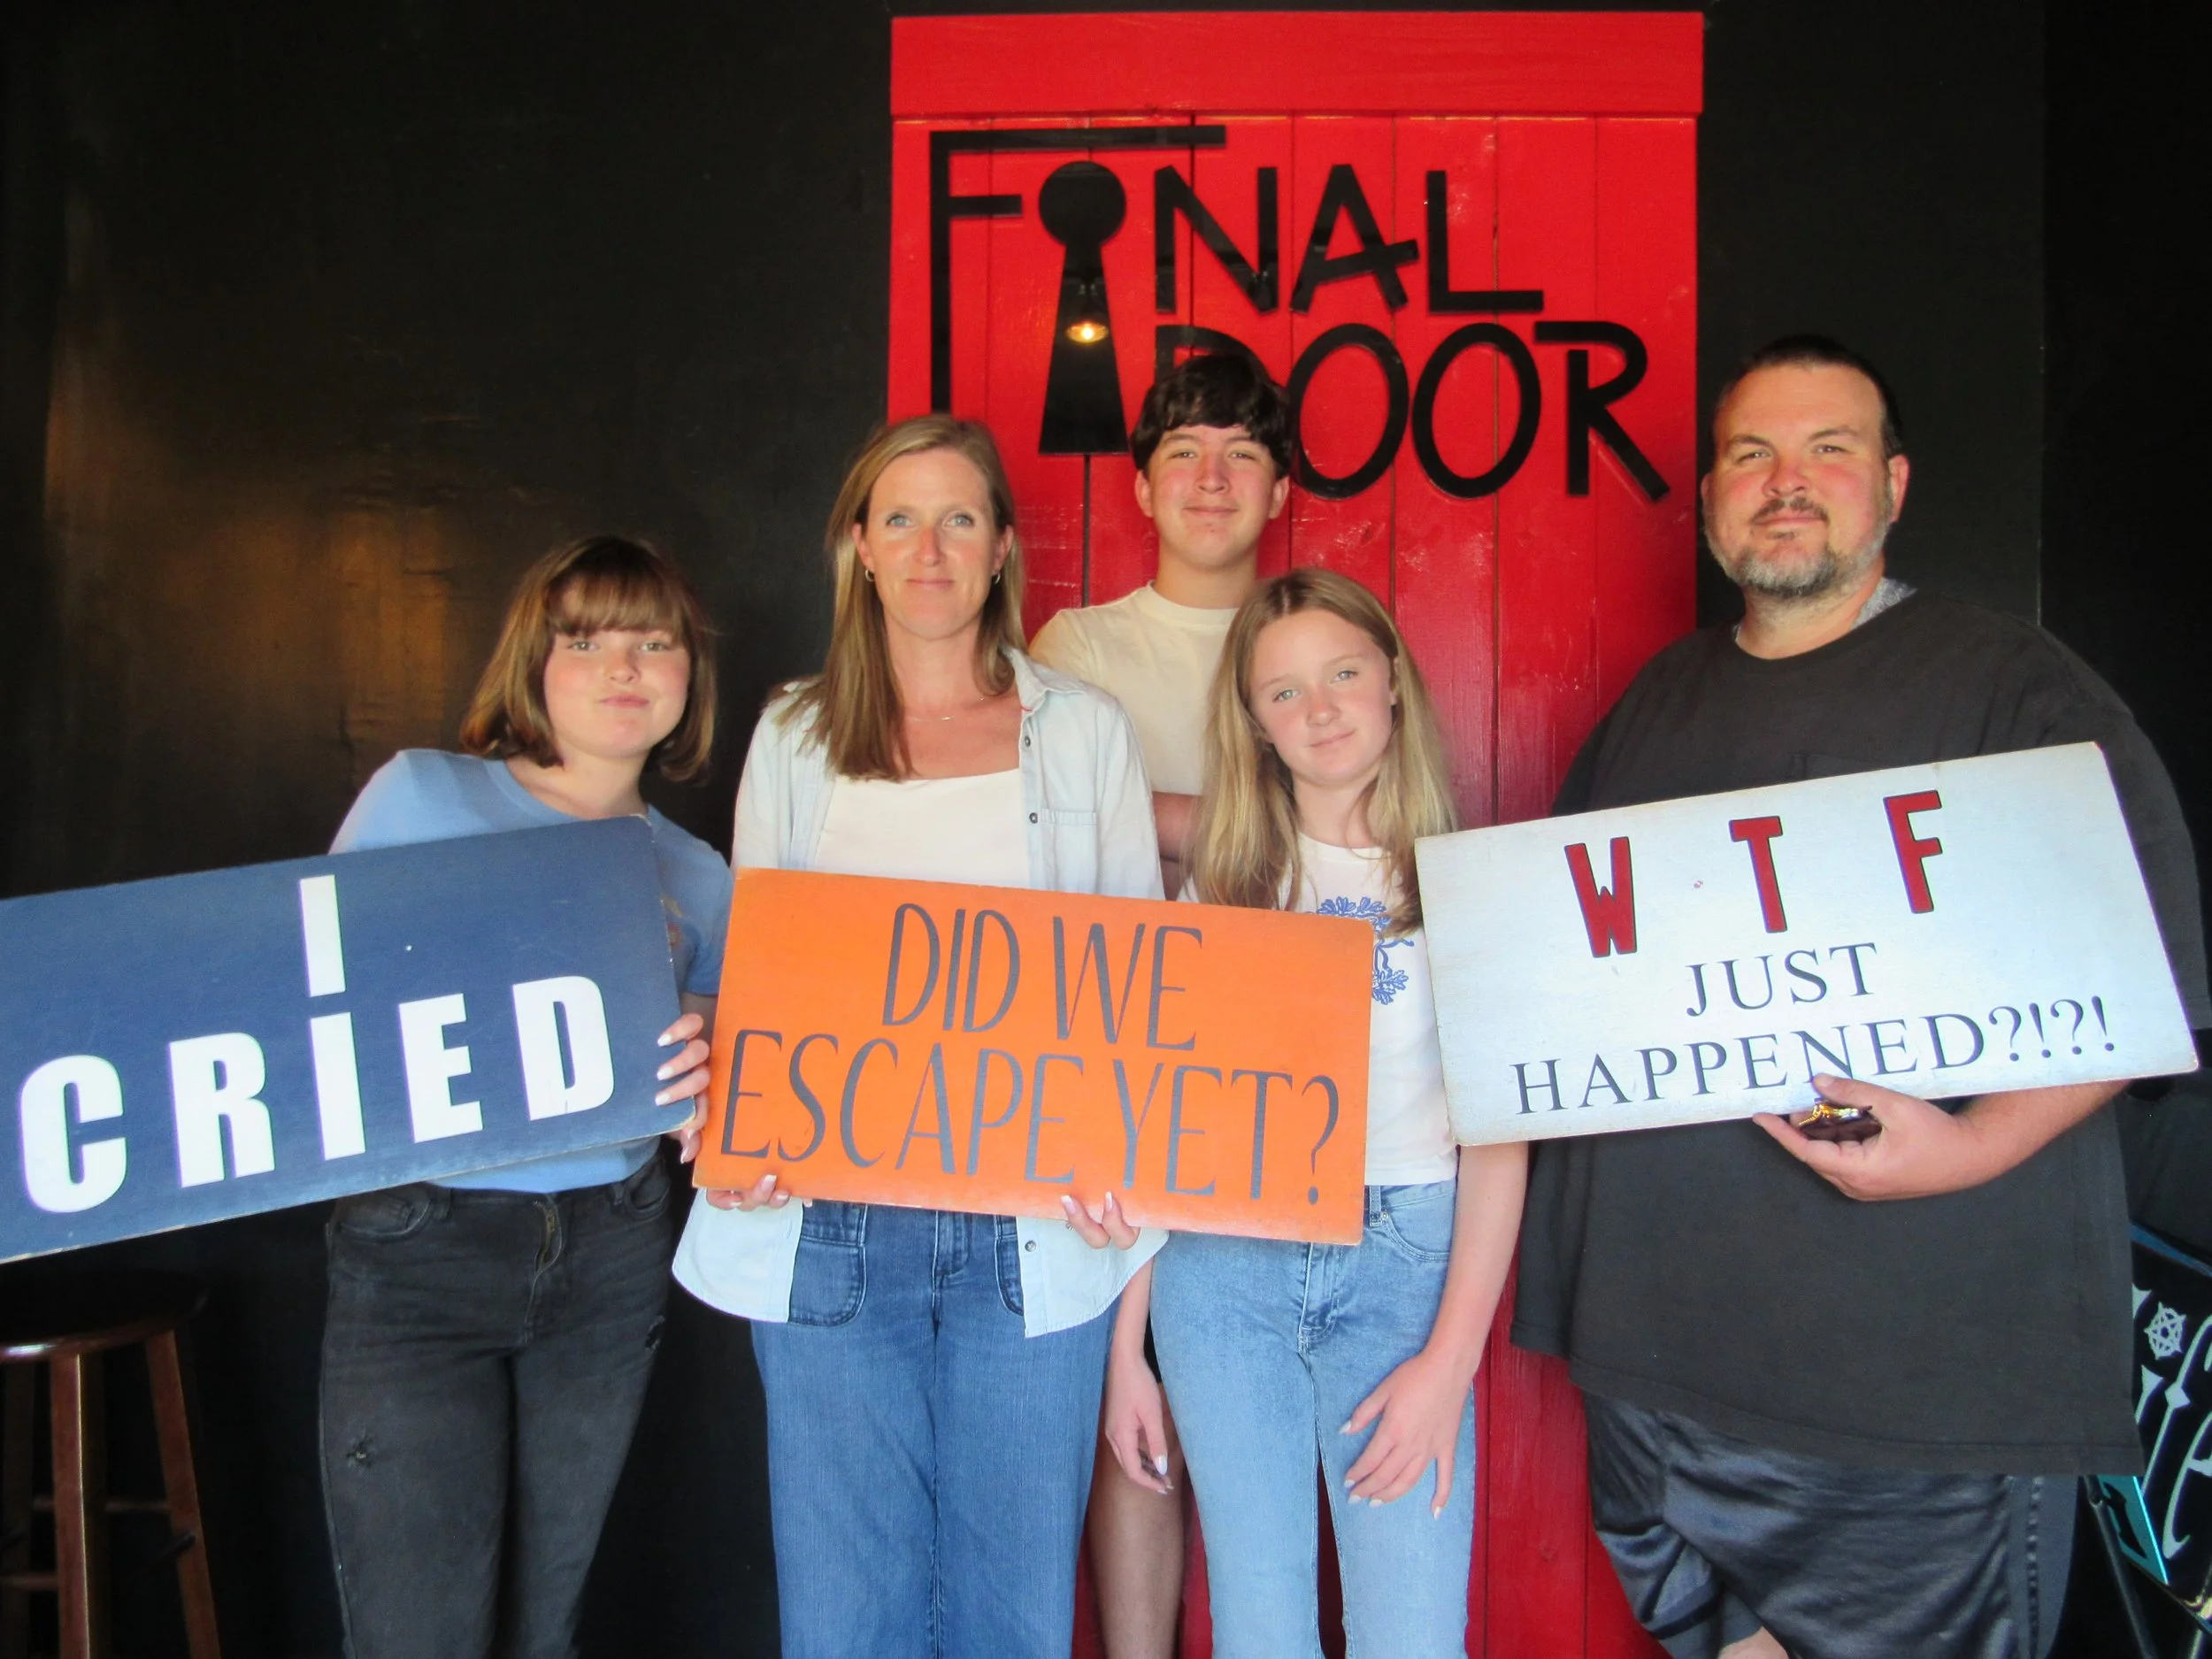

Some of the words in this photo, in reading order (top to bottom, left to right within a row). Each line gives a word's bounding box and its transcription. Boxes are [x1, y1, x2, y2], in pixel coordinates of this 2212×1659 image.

[299, 874, 346, 998] I
[881, 902, 1019, 1033] DID
[1052, 916, 1203, 1052] WE
[1686, 941, 1878, 1018] JUST
[20, 975, 615, 1213] CRIED
[720, 1028, 1085, 1184] ESCAPE
[1113, 1057, 1340, 1206] YET?
[1509, 995, 2116, 1116] HAPPENED?!?!
